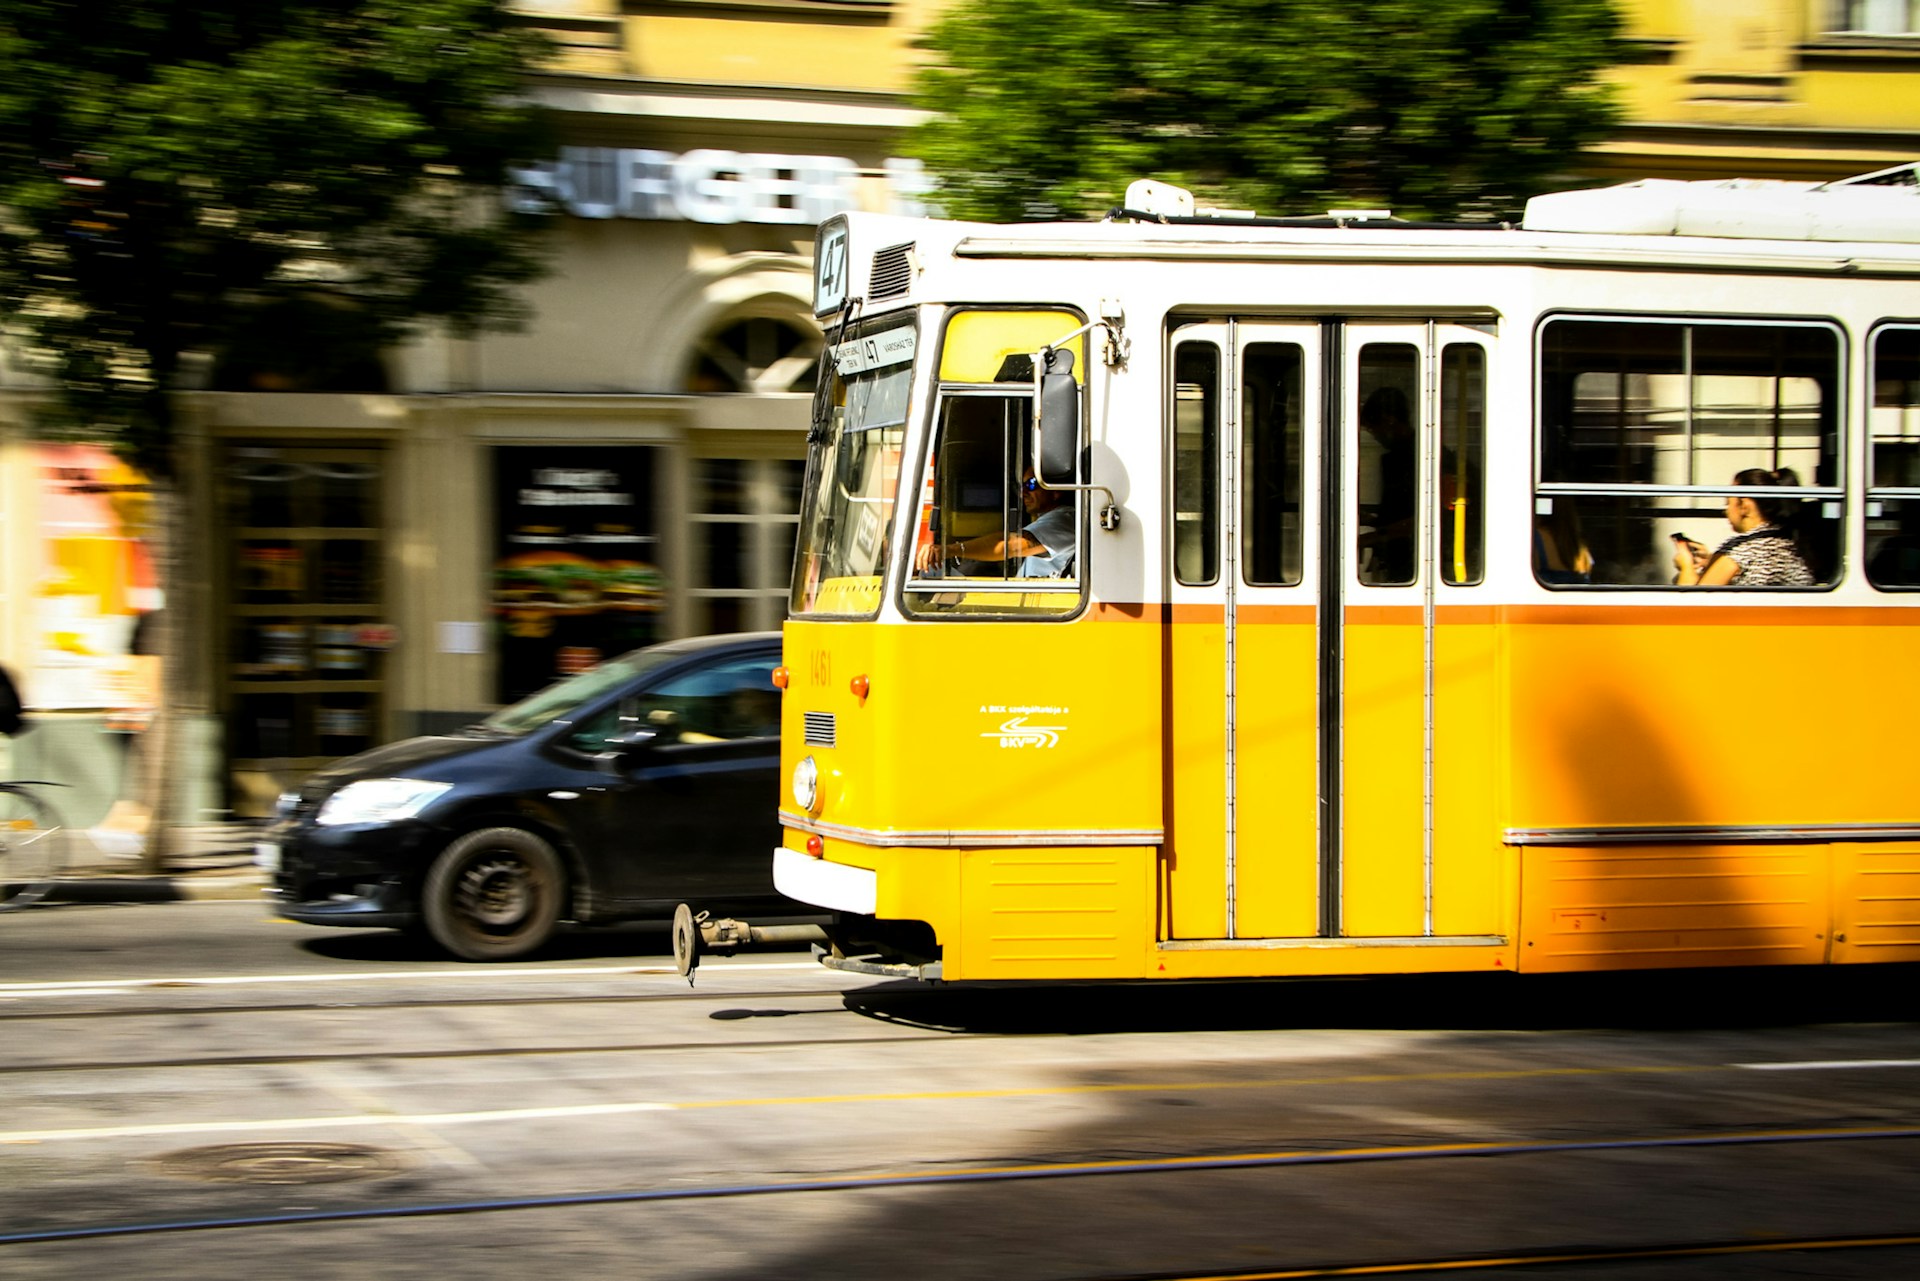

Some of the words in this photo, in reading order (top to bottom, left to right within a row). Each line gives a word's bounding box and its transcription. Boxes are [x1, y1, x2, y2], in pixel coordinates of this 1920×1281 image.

[821, 234, 847, 297] 47
[865, 339, 880, 363] 47
[810, 649, 831, 687] 1461
[1000, 738, 1025, 748] BKV
